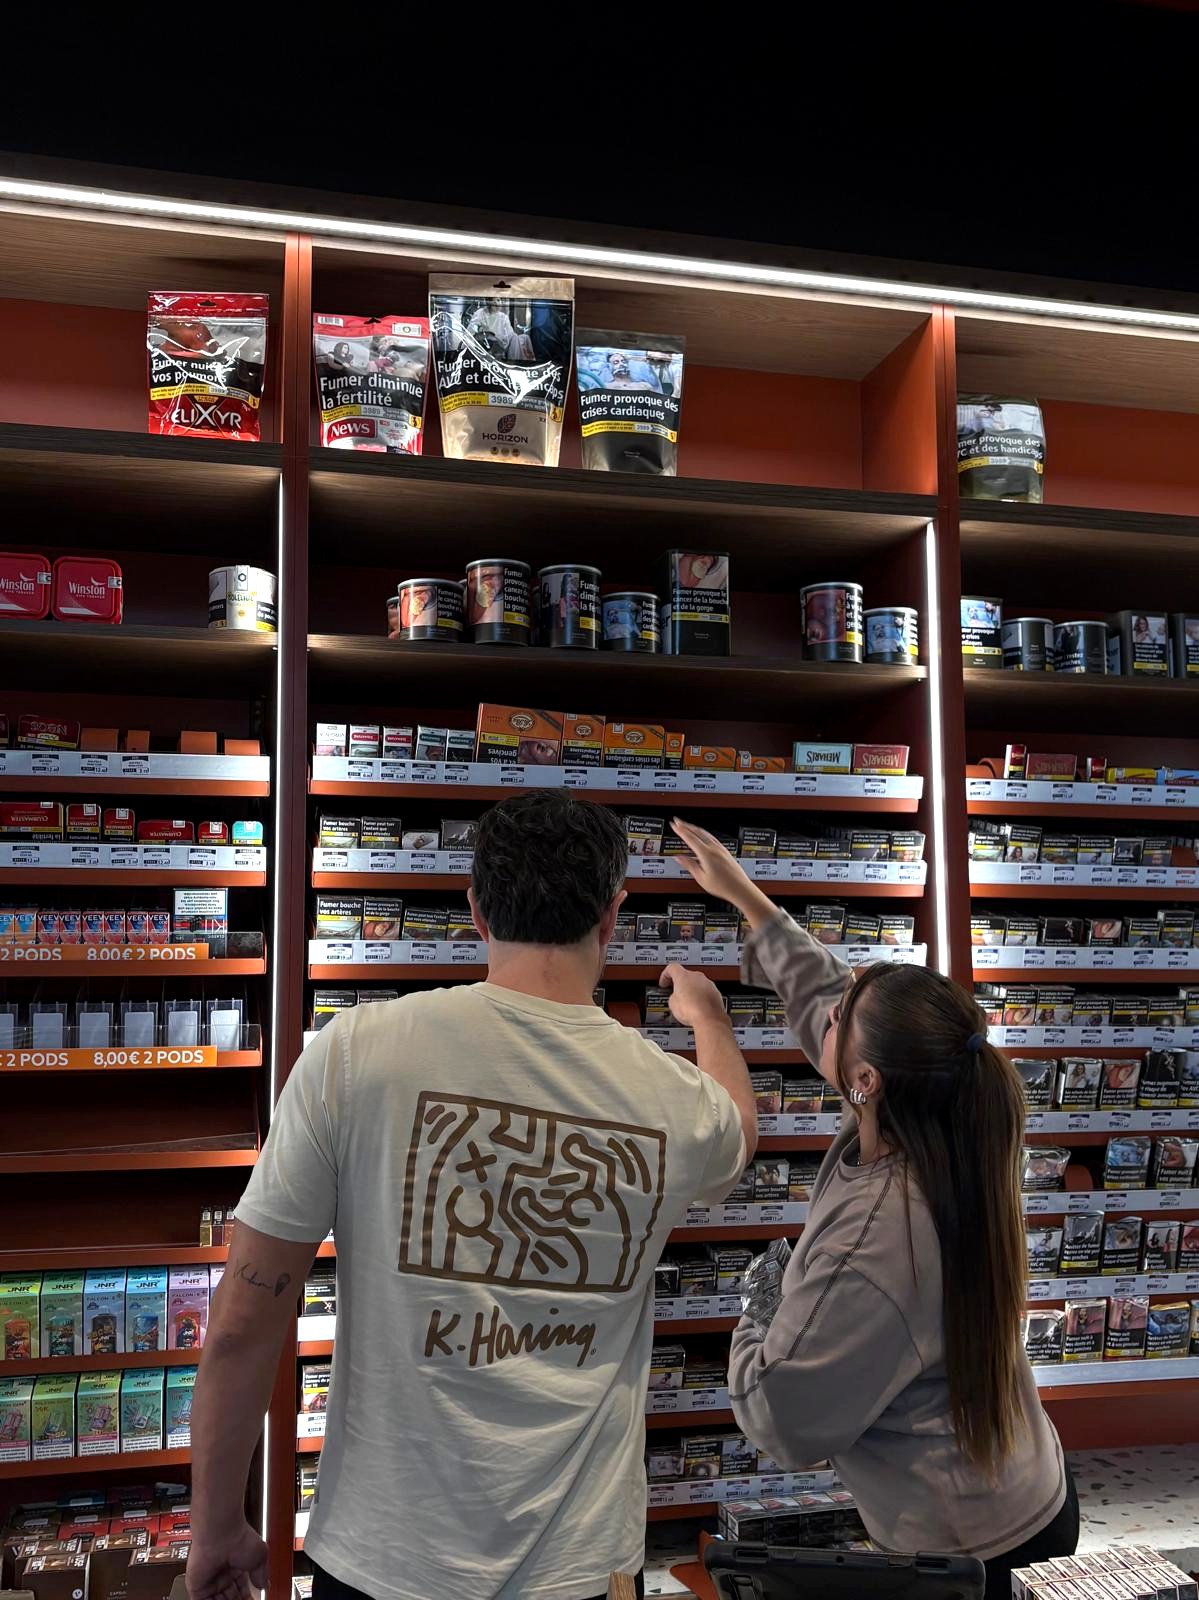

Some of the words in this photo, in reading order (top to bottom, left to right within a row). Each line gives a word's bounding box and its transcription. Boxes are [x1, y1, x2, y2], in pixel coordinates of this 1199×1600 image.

[153, 358, 188, 371] Fumer
[153, 370, 172, 383] vos
[175, 368, 227, 384] poumons
[466, 373, 480, 385] et
[483, 373, 504, 387] des
[320, 375, 364, 392] Fumer
[368, 373, 423, 398] diminue
[322, 395, 334, 410] la
[337, 390, 393, 407] fertilité
[491, 395, 514, 405] 3989
[581, 394, 612, 406] Fumer
[614, 395, 663, 408] provoque
[664, 399, 679, 412] des
[171, 403, 241, 429] ELIXYR
[582, 407, 608, 419] crises
[611, 406, 665, 421] cardiaques
[482, 433, 528, 445] HORIZON
[979, 436, 1023, 446] provoque
[1025, 438, 1041, 447] des
[969, 446, 980, 454] et
[982, 445, 999, 453] des
[1001, 444, 1043, 460] handicaps
[0, 578, 35, 592] Winston
[69, 582, 105, 596] Winston
[693, 590, 720, 598] provoque
[806, 751, 841, 764] MEHARI'S
[862, 752, 900, 767] MEHARI'S
[340, 901, 362, 909] bouche
[37, 914, 59, 922] VEEV
[59, 914, 81, 922] VEEV
[82, 914, 104, 922] VEEV
[104, 914, 126, 922] VEEV
[126, 914, 148, 922] VEEV
[148, 914, 170, 922] VEEV
[330, 908, 352, 916] artères
[1, 948, 10, 960] 2
[14, 948, 62, 960] PODS
[136, 947, 145, 960] 2
[150, 946, 196, 960] PODS
[7, 1054, 16, 1067] 2
[20, 1053, 69, 1067] PODS
[94, 1052, 140, 1068] 8,00€
[143, 1051, 152, 1064] 2
[156, 1050, 204, 1064] PODS
